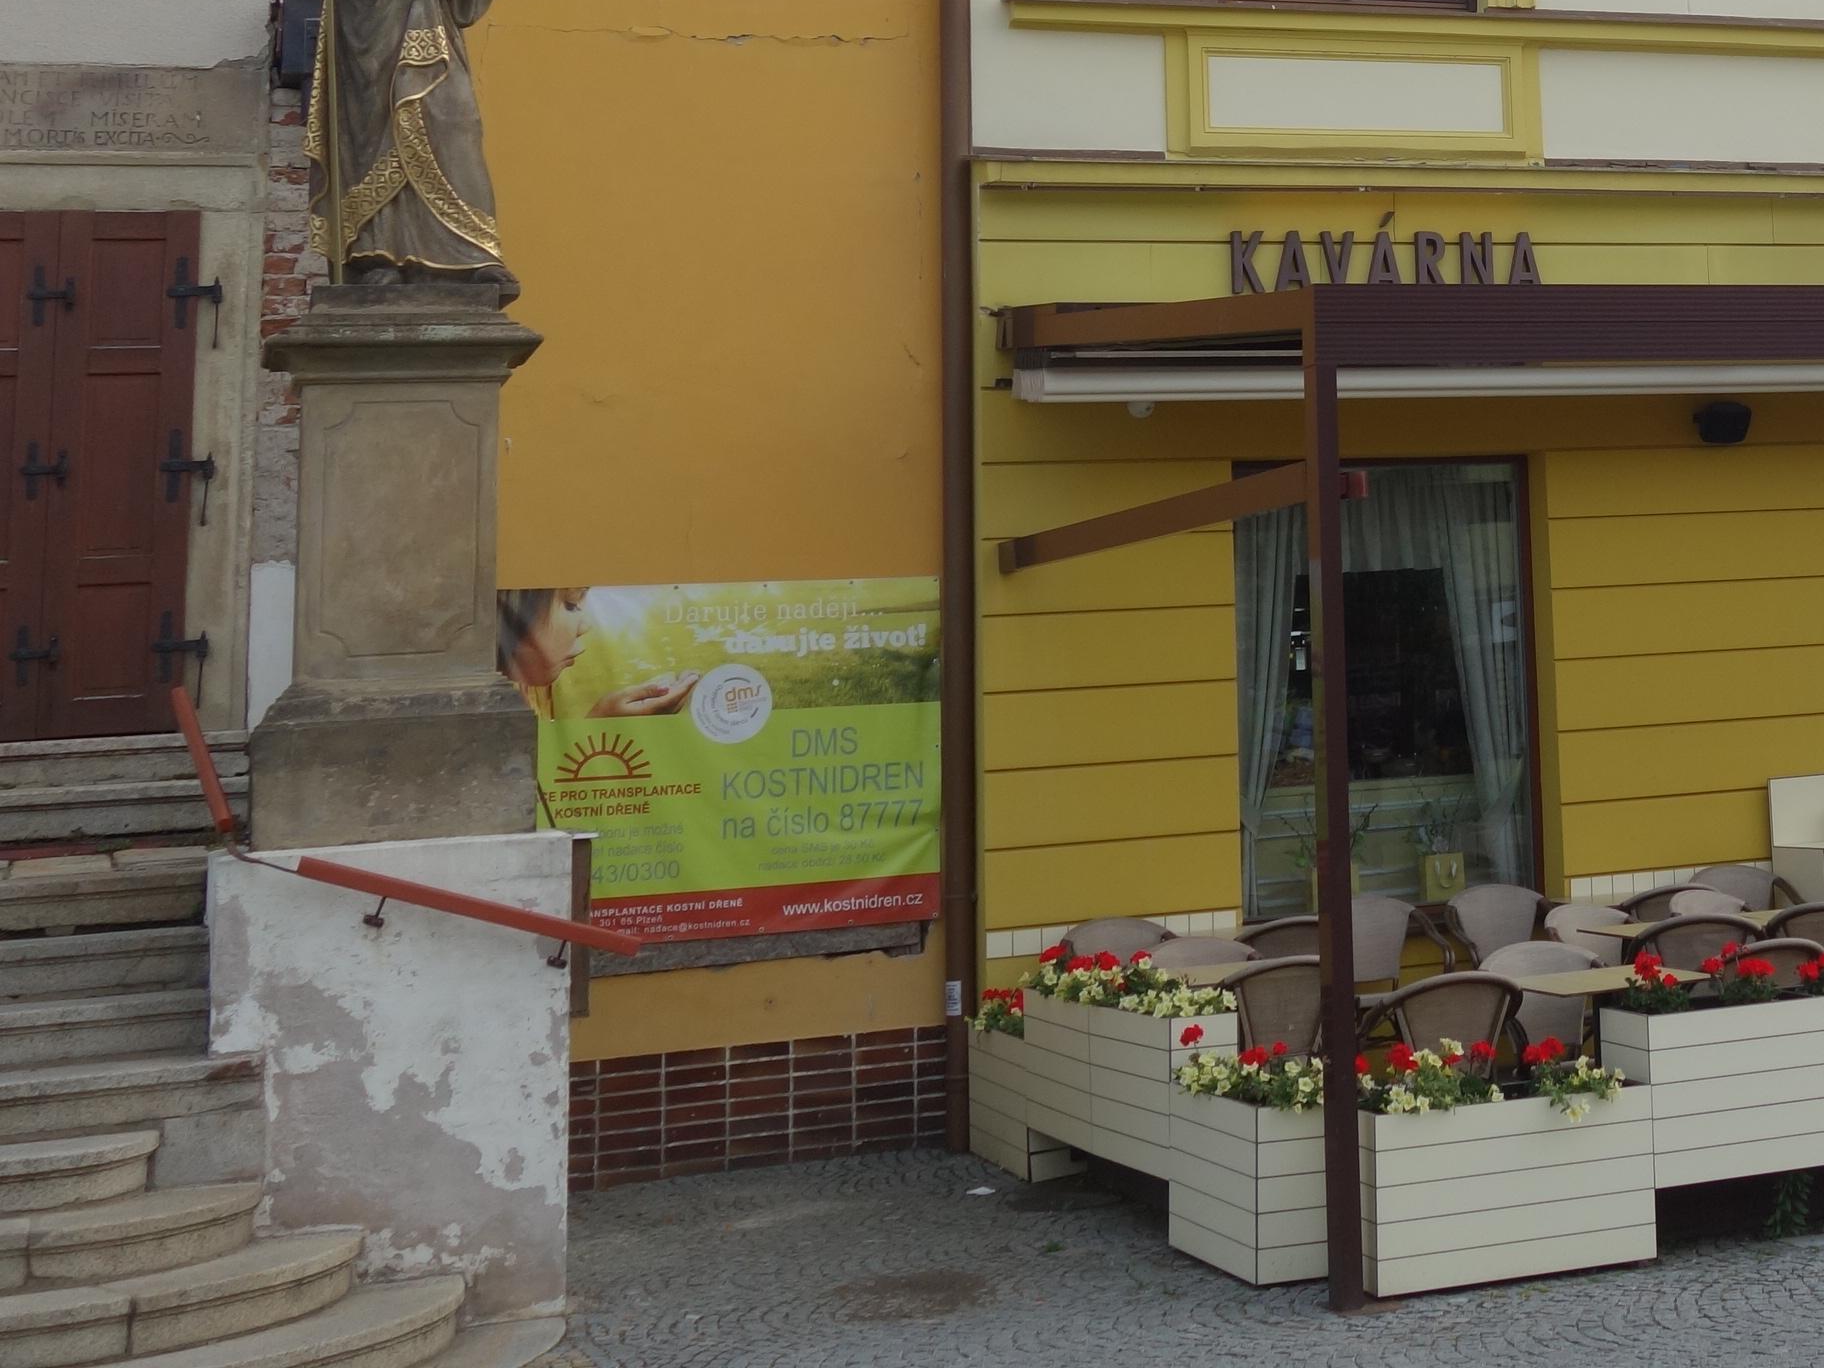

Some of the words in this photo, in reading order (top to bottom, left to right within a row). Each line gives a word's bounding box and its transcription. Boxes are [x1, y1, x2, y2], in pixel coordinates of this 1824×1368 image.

[1230, 211, 1542, 294] KAVÁRNA
[664, 601, 768, 624] Darujte
[843, 623, 927, 649] život!
[725, 684, 762, 703] dms
[791, 726, 858, 759] DMS
[560, 789, 588, 802] PRO
[591, 783, 702, 800] TRANSPLANTACE
[722, 761, 925, 801] KOSTNIDREN
[554, 803, 603, 819] KOSTNÍ
[606, 800, 651, 817] DŘENĚ
[722, 812, 756, 841] na
[767, 803, 830, 836] číslo
[839, 799, 925, 832] 87777
[666, 900, 706, 913] KOSTNÍ
[708, 897, 744, 909] DŘENĚ
[782, 890, 924, 917] www.kostnidren.cz
[635, 914, 663, 925] Plzeň
